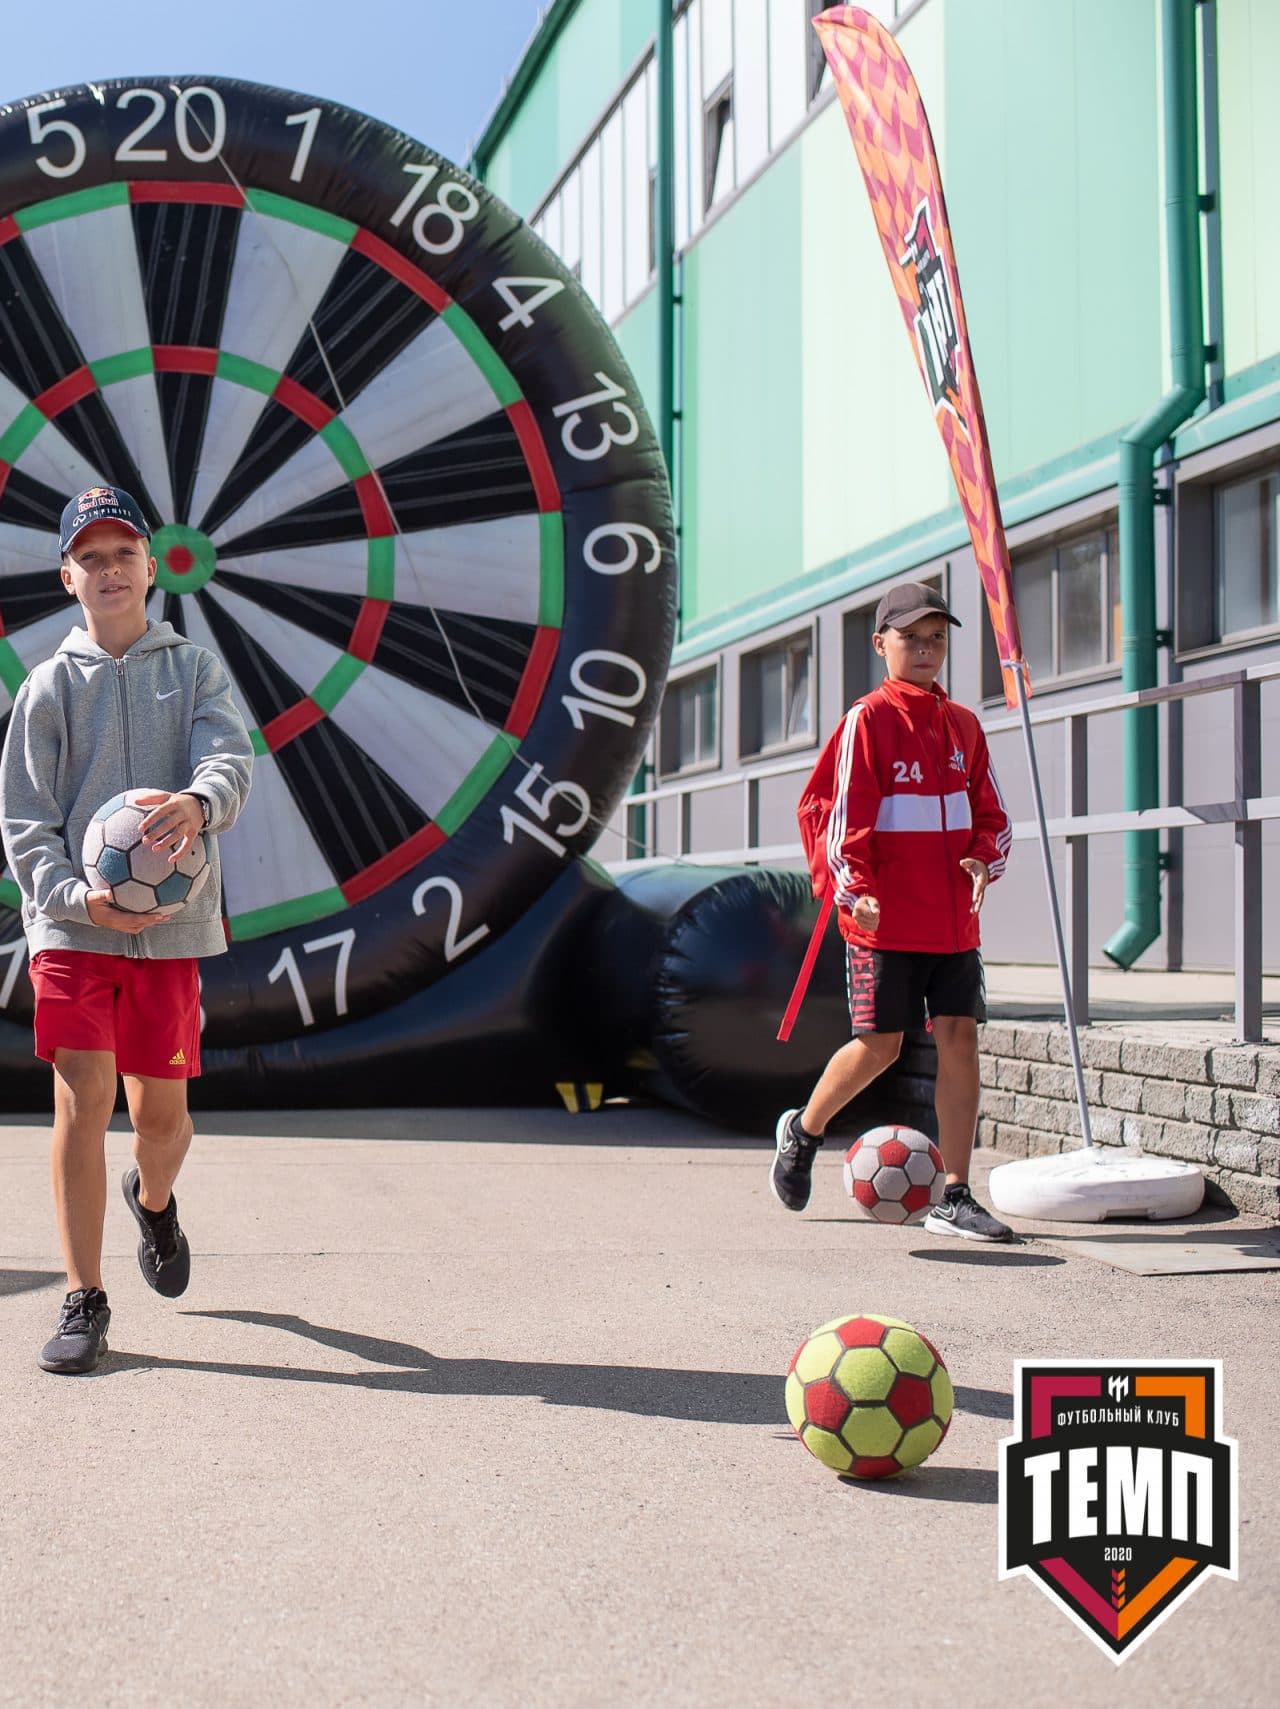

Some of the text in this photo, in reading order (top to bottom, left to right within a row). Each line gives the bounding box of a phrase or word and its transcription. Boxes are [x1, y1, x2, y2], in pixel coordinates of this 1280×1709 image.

[25, 98, 86, 179] 5
[114, 86, 227, 164] 20
[284, 107, 323, 184] 1
[388, 162, 480, 255] 18
[491, 275, 566, 333] 4
[551, 371, 640, 462] 13
[560, 648, 648, 732] 10
[499, 761, 591, 859] 15
[892, 761, 924, 784] 24
[411, 875, 491, 964] 2
[266, 928, 356, 1027] 17
